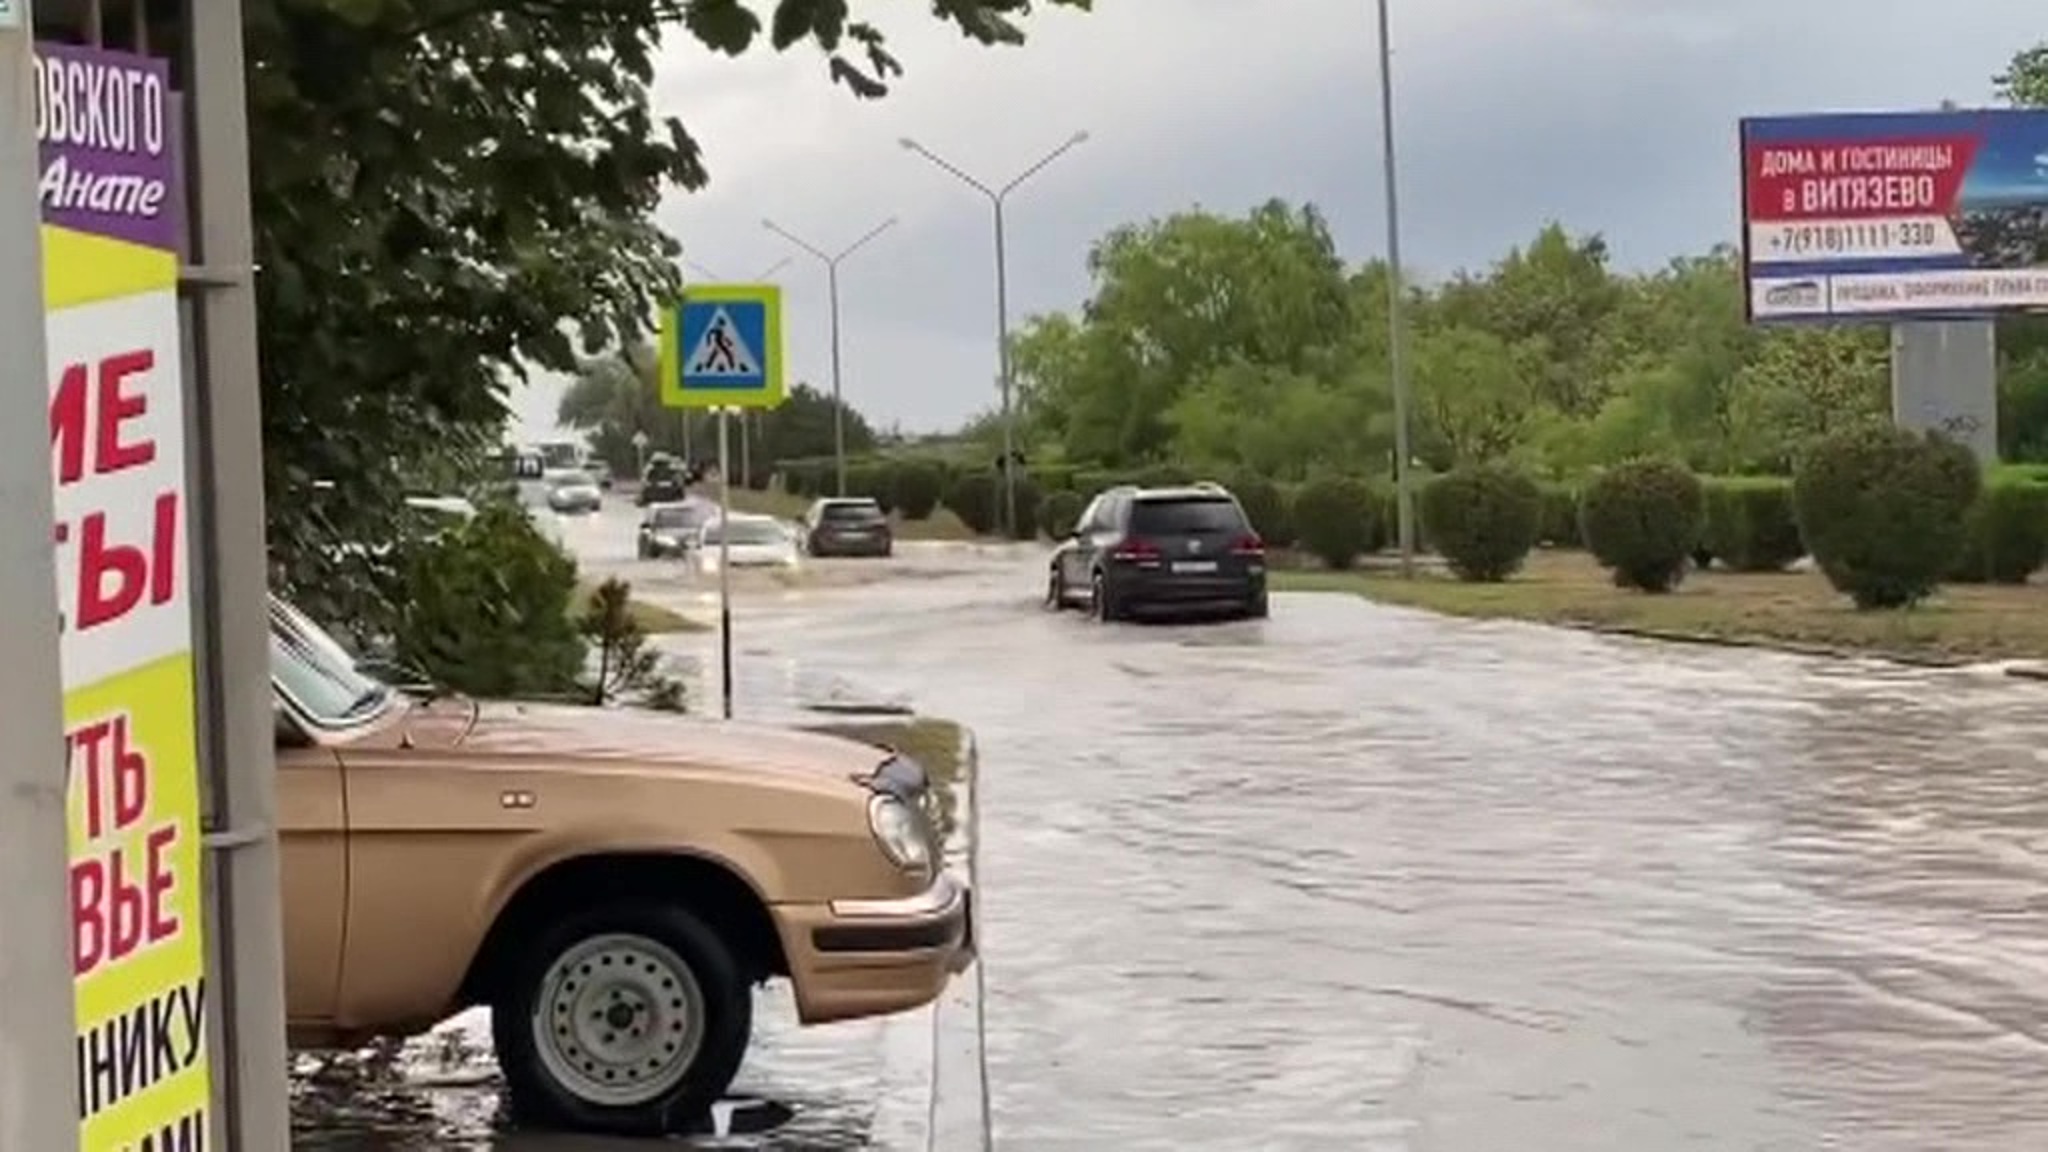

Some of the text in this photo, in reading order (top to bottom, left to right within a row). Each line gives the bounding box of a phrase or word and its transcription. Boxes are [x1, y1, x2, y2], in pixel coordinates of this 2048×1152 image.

[39, 155, 165, 215] Анапе
[1761, 146, 1952, 177] ДОМА И ГОСТИНИЦЫ
[1803, 176, 1934, 212] ВИТЯЗЕВО
[65, 713, 146, 839] ТЬ
